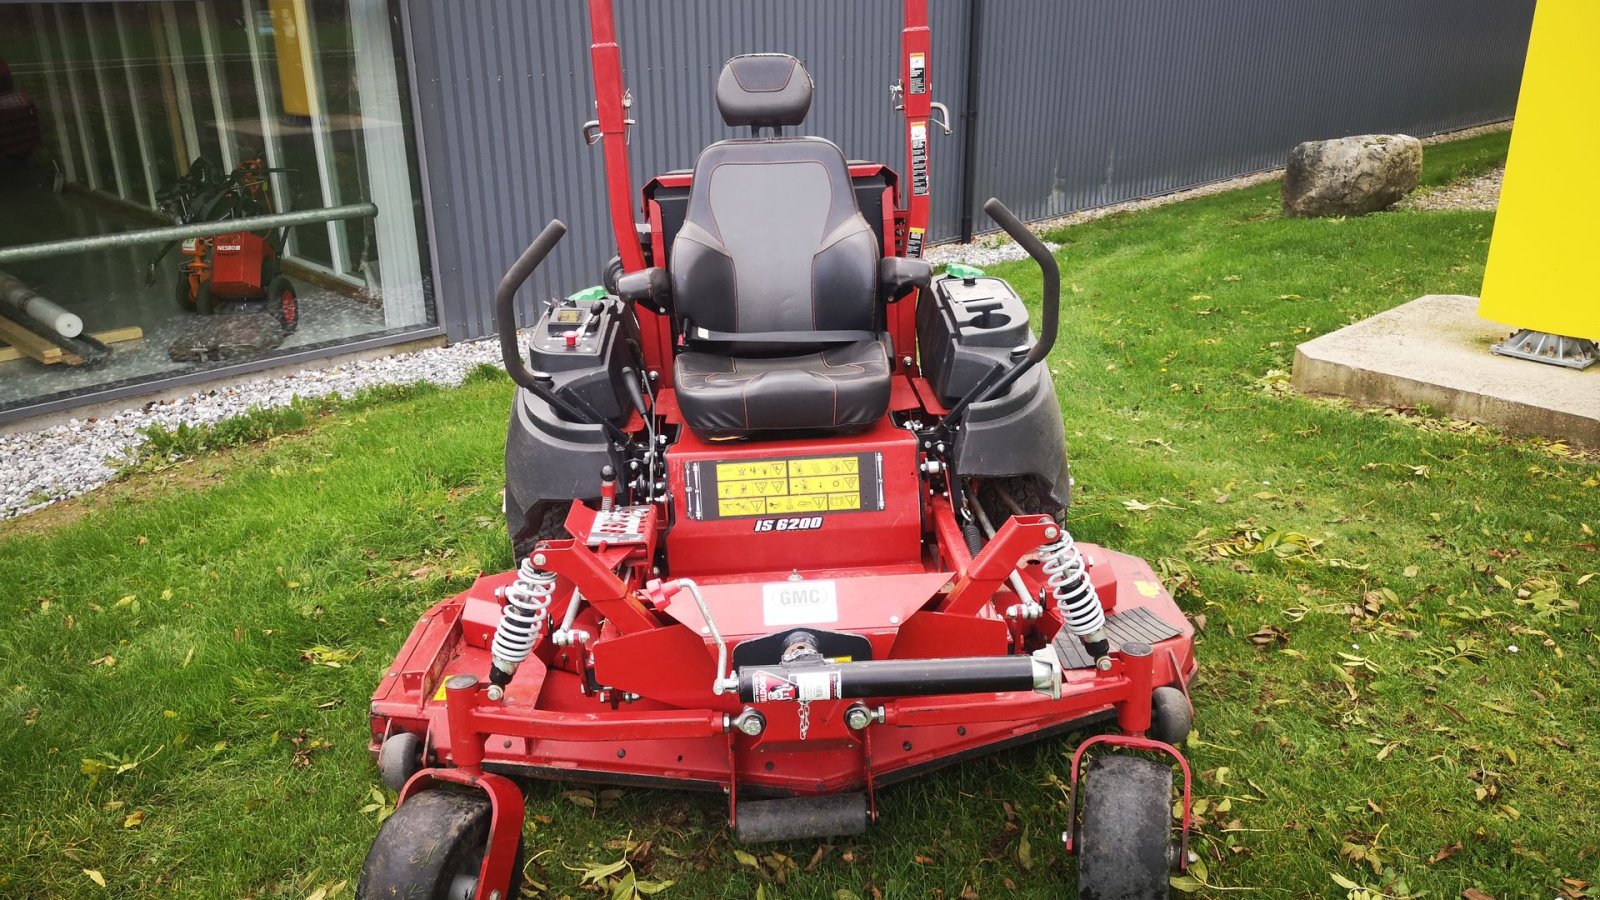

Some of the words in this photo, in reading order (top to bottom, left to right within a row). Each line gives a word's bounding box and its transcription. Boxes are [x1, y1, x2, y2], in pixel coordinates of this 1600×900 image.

[754, 519, 775, 532] IS
[776, 516, 823, 531] 6200
[780, 589, 820, 605] GMC
